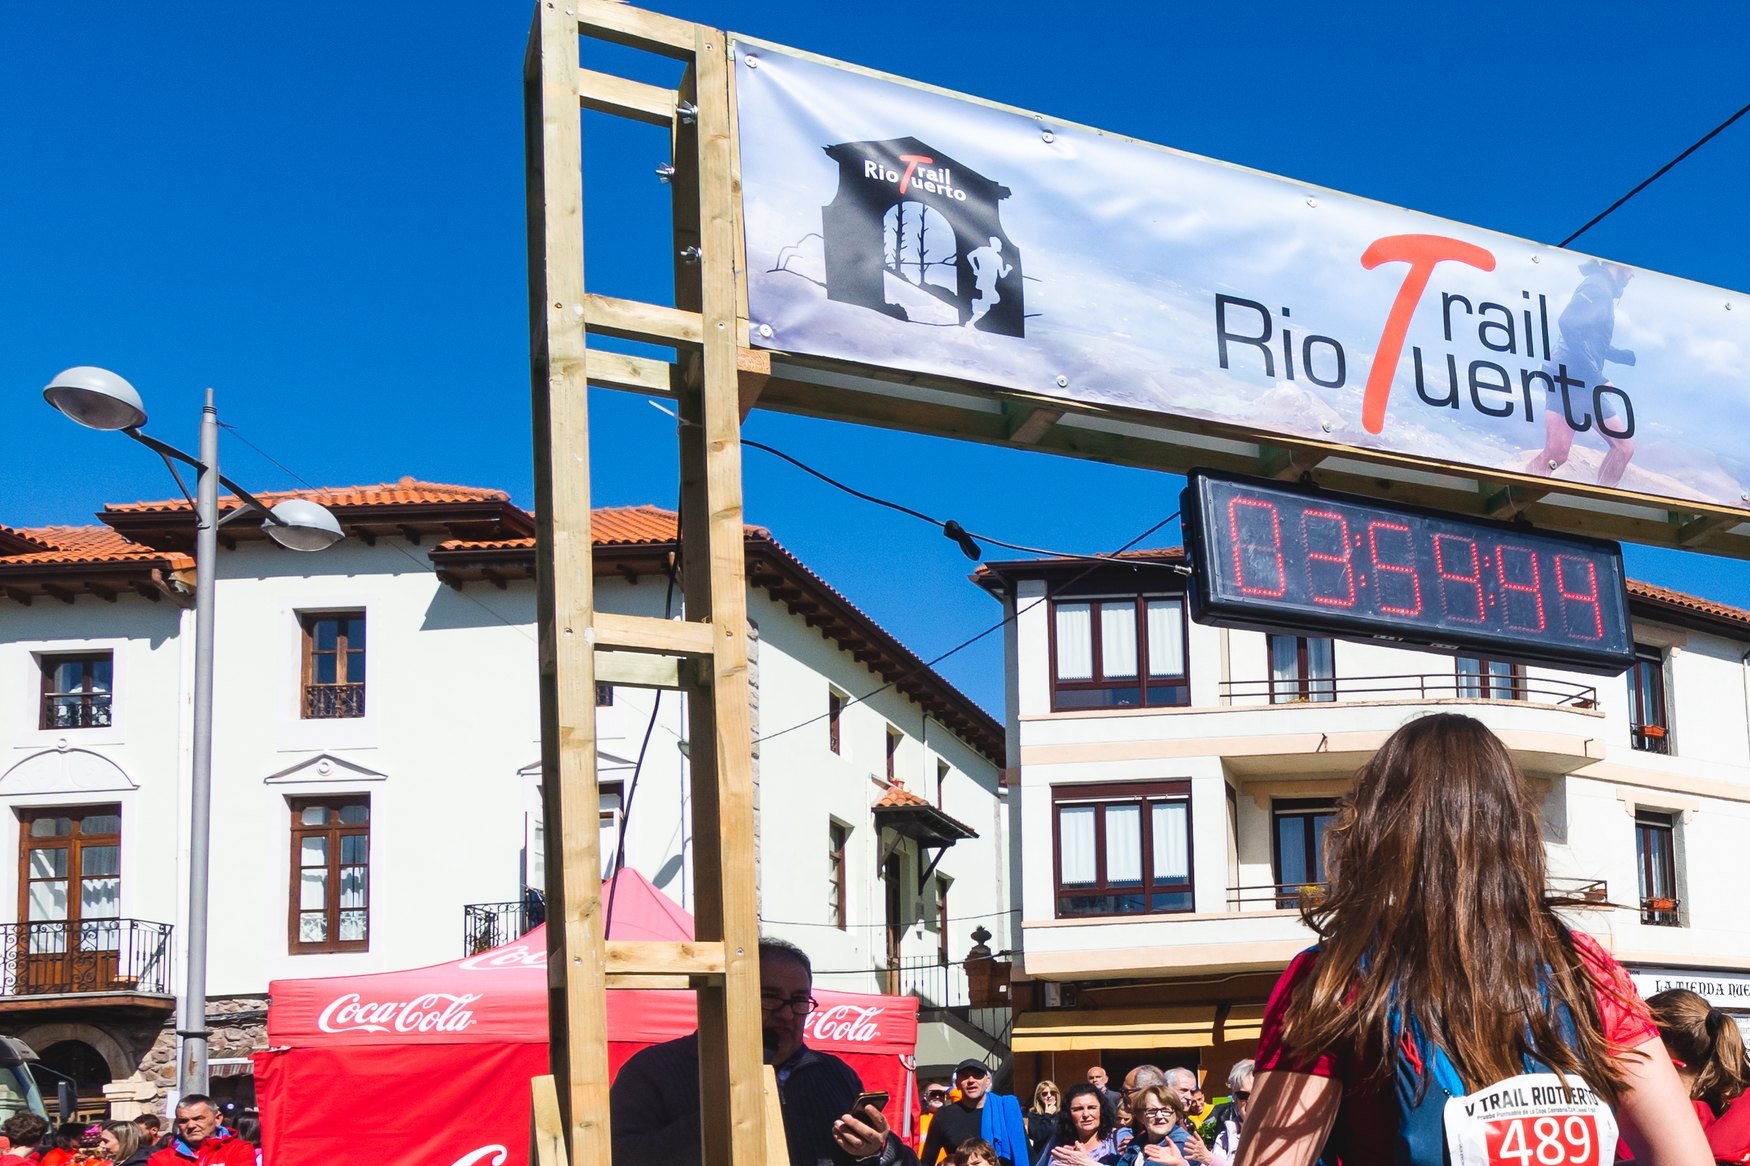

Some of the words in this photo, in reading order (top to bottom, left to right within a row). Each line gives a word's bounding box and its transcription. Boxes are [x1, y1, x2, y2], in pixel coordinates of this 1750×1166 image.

[864, 159, 899, 183] Rio
[1214, 293, 1347, 390] Rio
[1655, 980, 1672, 993] LA
[1676, 980, 1725, 996] TIENDA
[318, 993, 483, 1034] Coca-Cola
[804, 1005, 885, 1042] -Cola
[1464, 1102, 1475, 1117] V
[1479, 1088, 1529, 1113] TRAIL
